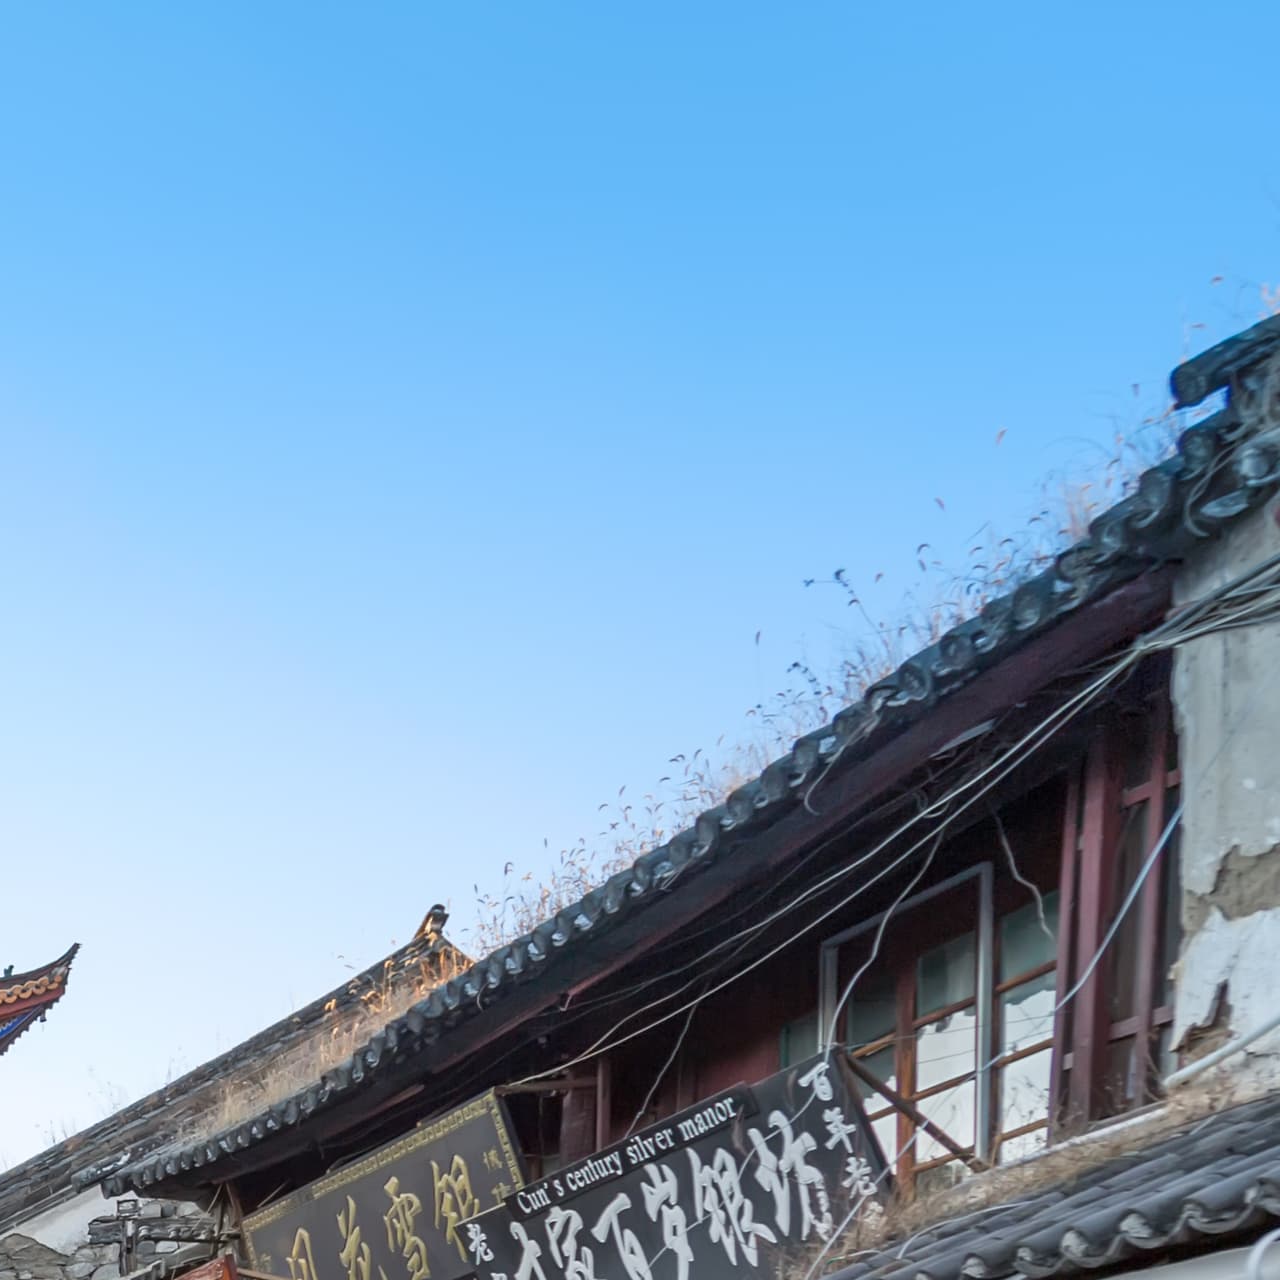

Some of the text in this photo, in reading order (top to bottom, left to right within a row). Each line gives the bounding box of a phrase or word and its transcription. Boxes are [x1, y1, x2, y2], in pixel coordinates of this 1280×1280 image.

[566, 1150, 624, 1192] century
[627, 1126, 675, 1164] silver
[679, 1095, 738, 1143] manor
